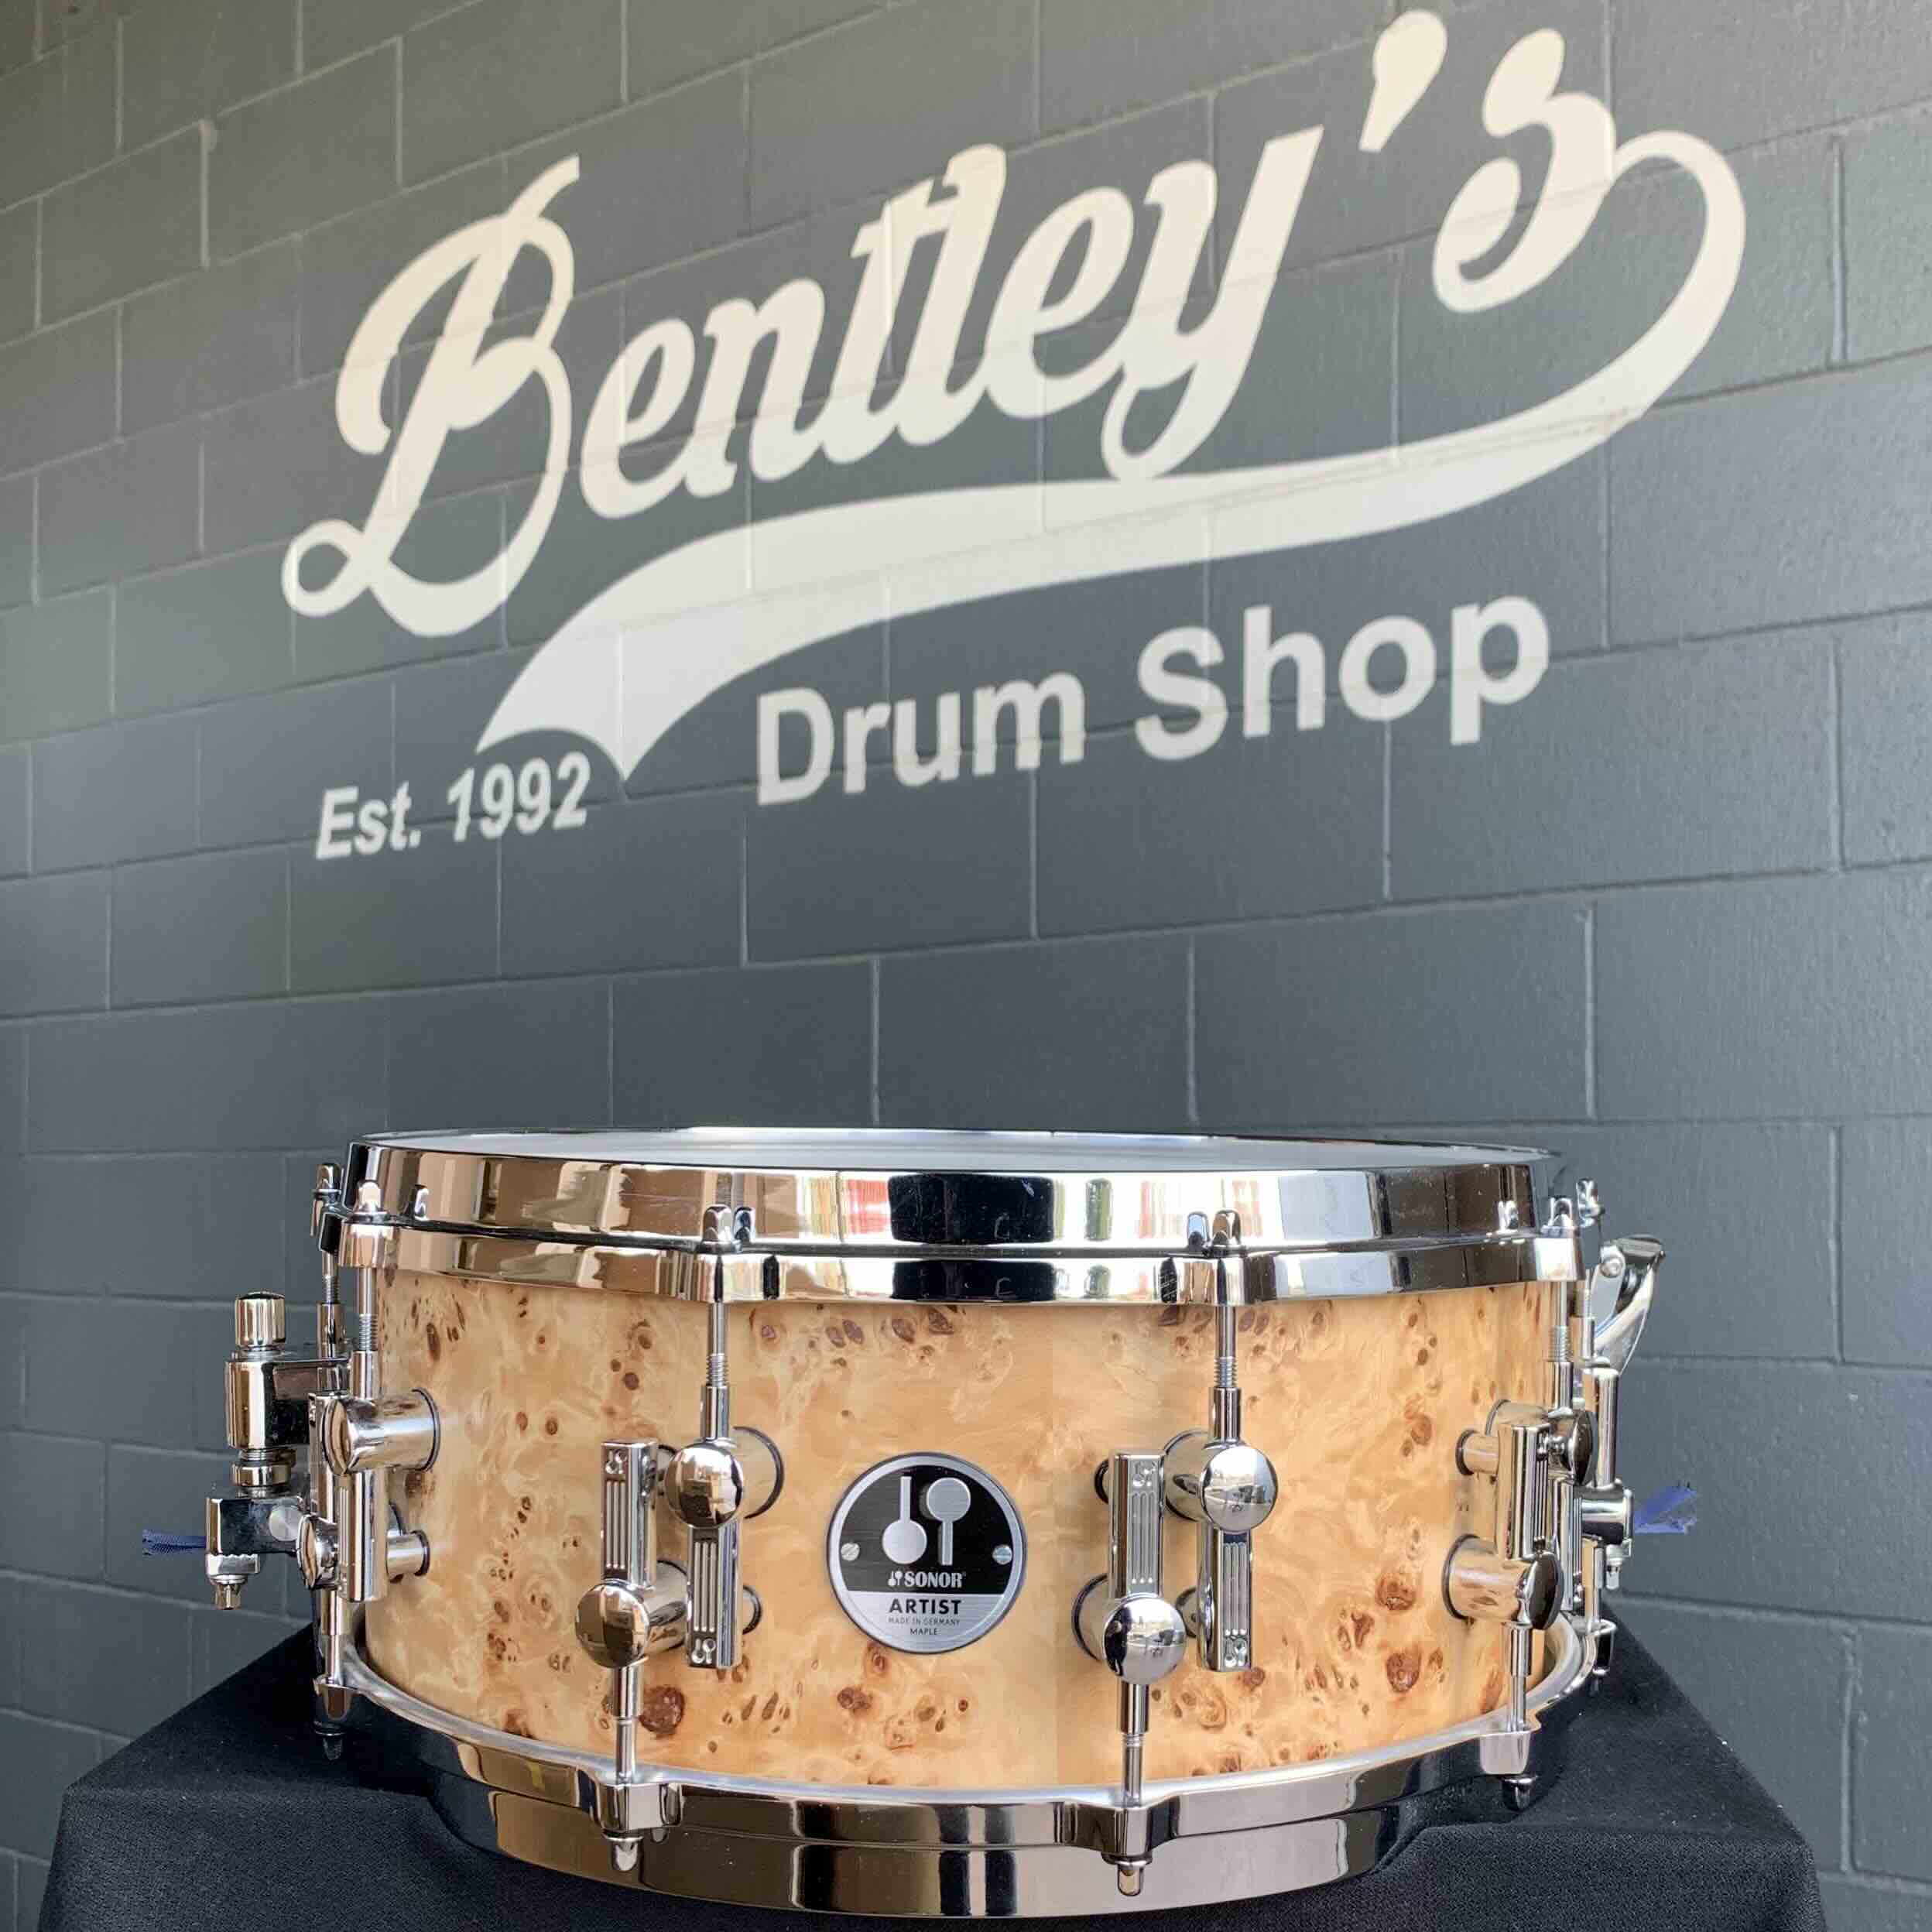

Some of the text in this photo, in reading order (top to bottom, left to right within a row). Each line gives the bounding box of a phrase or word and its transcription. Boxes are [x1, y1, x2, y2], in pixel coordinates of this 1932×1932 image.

[282, 9, 1746, 637] Bentley's
[757, 595, 1549, 805] Drum Shop
[316, 752, 591, 860] Est. 1992
[889, 1598, 962, 1615] ARTIST
[904, 1571, 963, 1588] SONOR
[888, 1616, 961, 1626] MADE IN GERMANY
